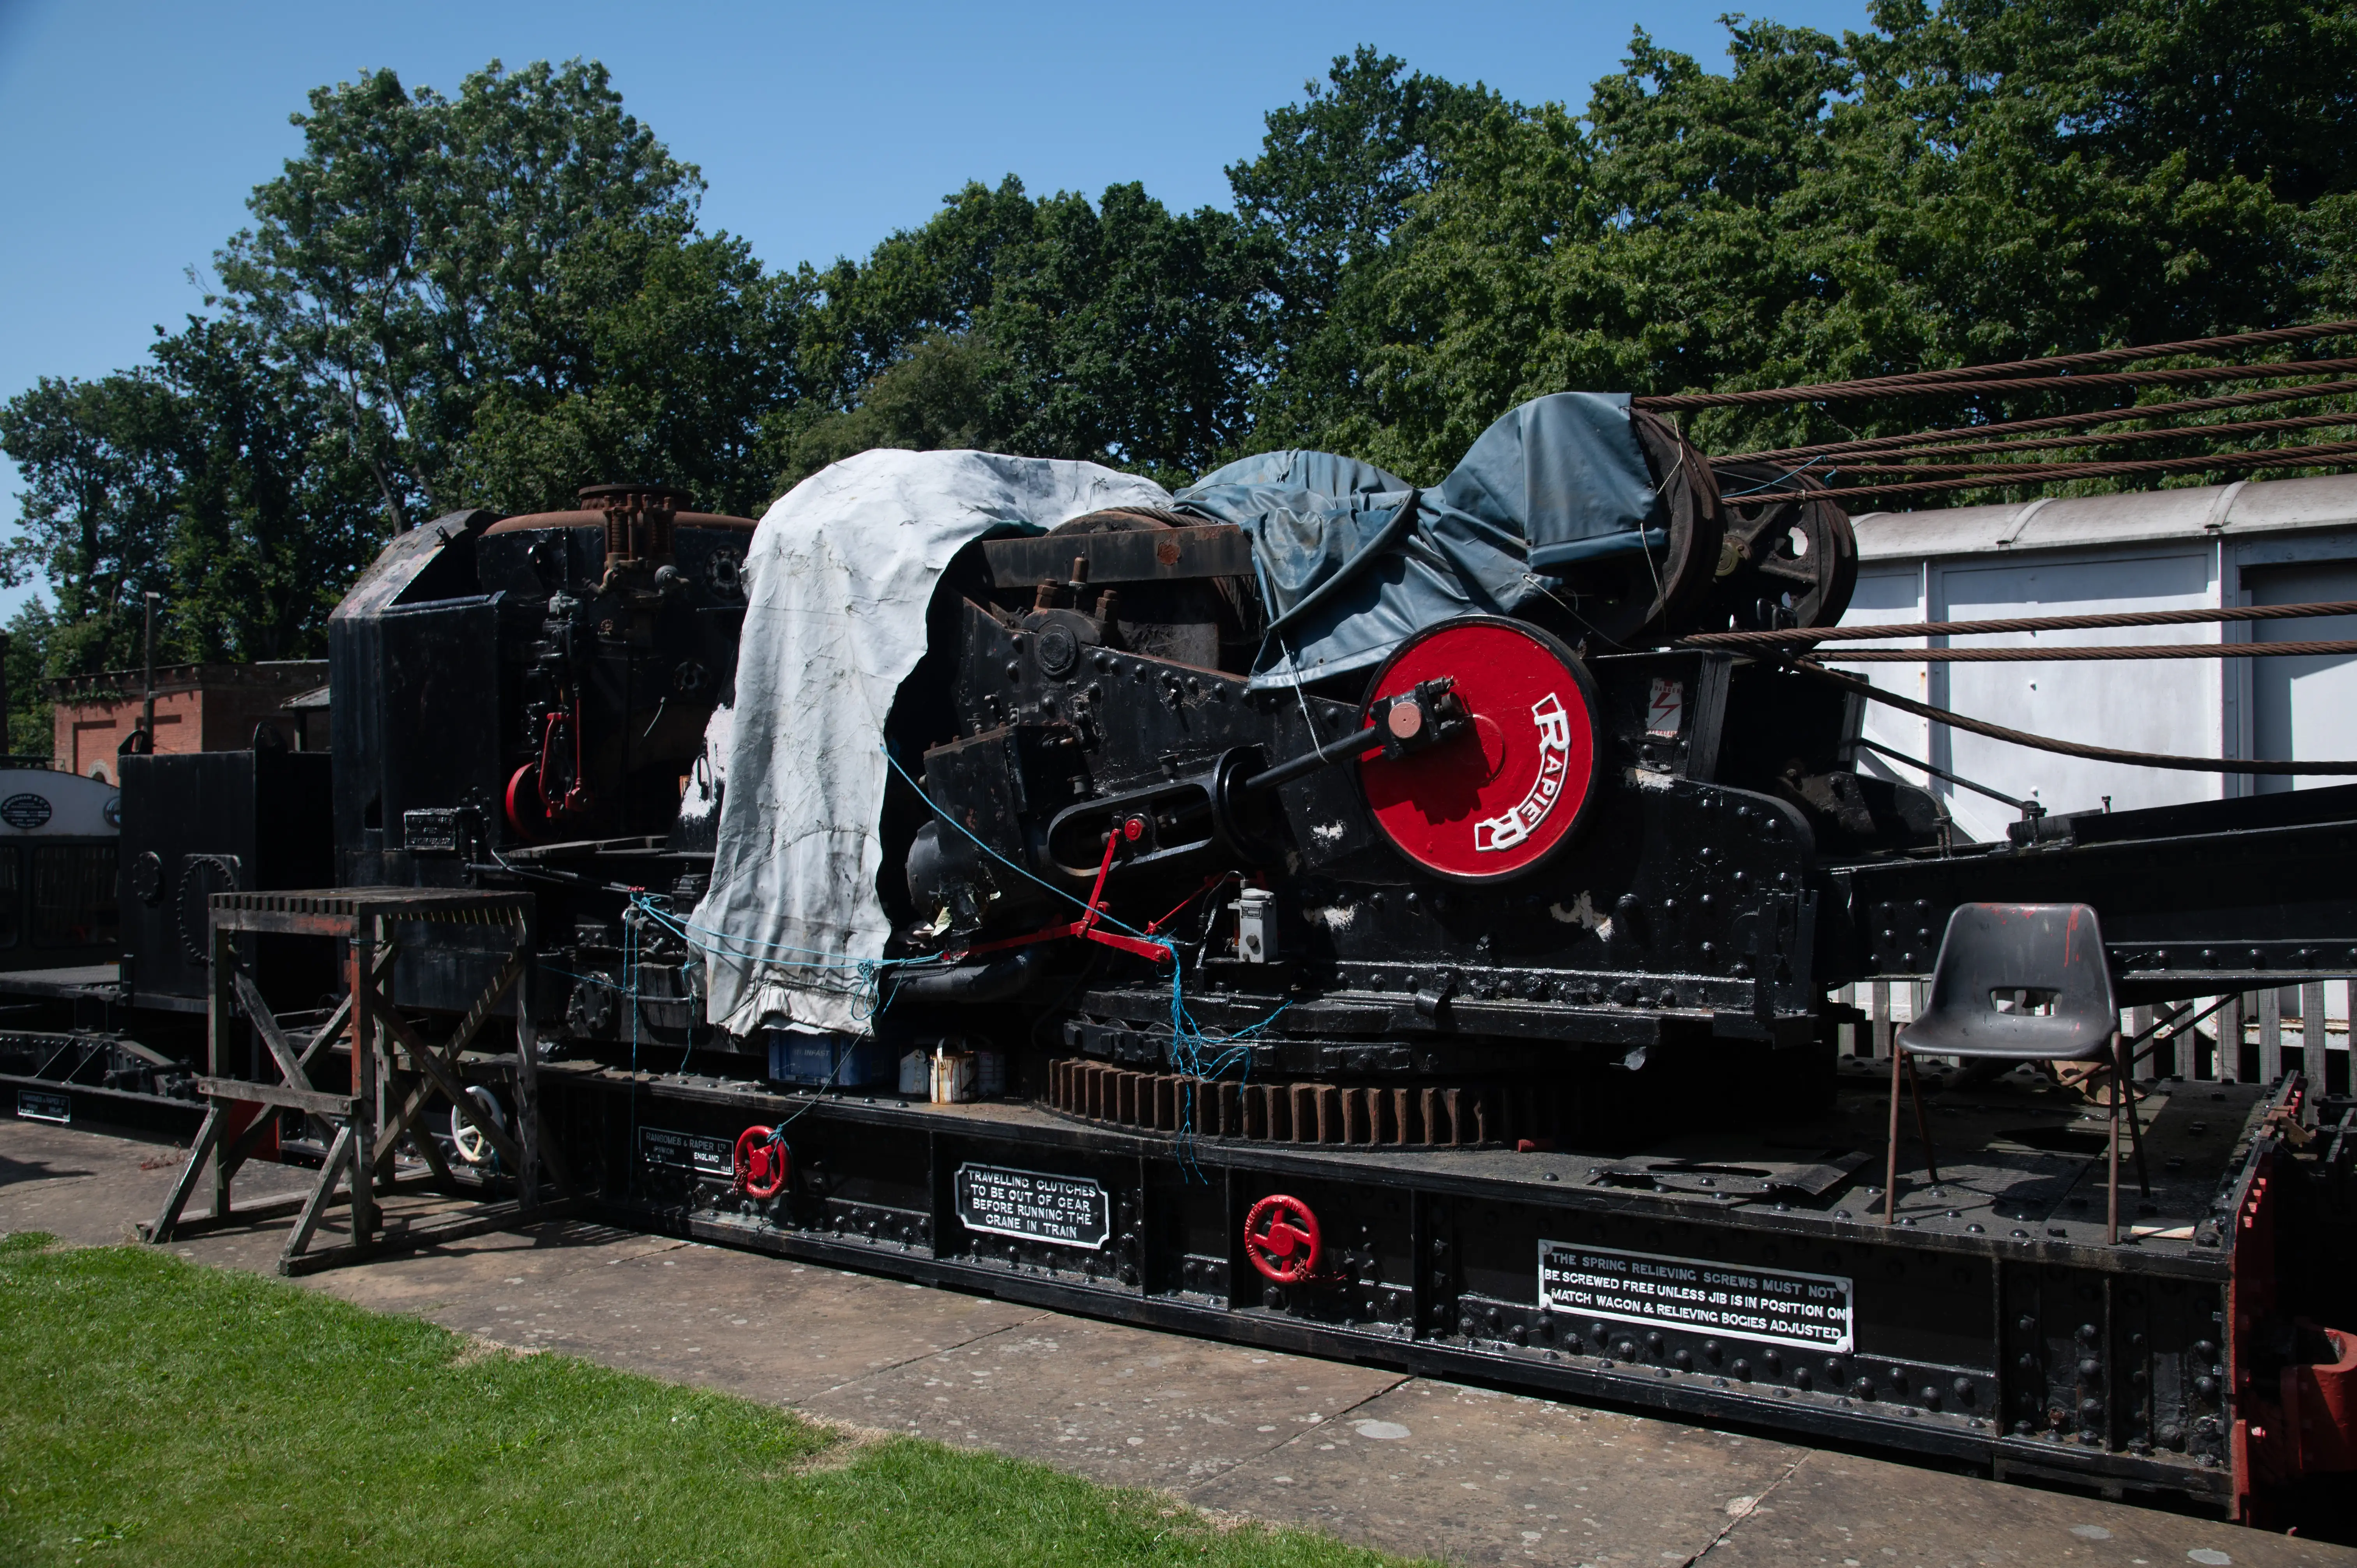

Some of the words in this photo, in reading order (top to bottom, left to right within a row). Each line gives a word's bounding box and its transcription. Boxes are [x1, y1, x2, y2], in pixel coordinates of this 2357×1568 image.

[1655, 685, 1680, 694] DANGER
[1489, 709, 1571, 850] RAPIER
[804, 1049, 830, 1057] INFAST
[646, 1132, 681, 1146] RANSOMES
[689, 1139, 714, 1151] RAPIER
[694, 1152, 719, 1163] ENGLAND
[967, 1170, 1030, 1188] TRAVELLING
[1037, 1180, 1096, 1197] CLUTCHES
[970, 1184, 986, 1196] TO
[991, 1187, 1005, 1199] BE
[1009, 1190, 1034, 1203] OUT
[1038, 1194, 1052, 1206] OF
[1058, 1197, 1090, 1212] GEAR
[973, 1198, 1013, 1215] BEFORE
[1018, 1204, 1063, 1221] RUNNING
[1067, 1211, 1092, 1225] THE
[986, 1214, 1021, 1229] CRANE
[1027, 1220, 1037, 1232] IN
[1043, 1223, 1077, 1239] TRAIN
[1551, 1252, 1577, 1266] THE
[1582, 1256, 1627, 1272] SPRING
[1632, 1263, 1697, 1281] RELIEVING
[1703, 1272, 1758, 1289] SCREWS
[1763, 1279, 1803, 1296] MUST
[1808, 1285, 1837, 1300] NOT
[1544, 1269, 1560, 1282] BE
[1562, 1271, 1619, 1289] SCREWED
[1623, 1280, 1655, 1294] FREE
[1657, 1286, 1706, 1302] UNLESS
[1709, 1292, 1727, 1305] JIB
[1730, 1295, 1743, 1307] IS
[1745, 1296, 1757, 1309] IN
[1760, 1298, 1824, 1318] POSITION
[1827, 1307, 1846, 1321] ON
[1551, 1288, 1592, 1305] MATCH
[1596, 1295, 1640, 1312] WAGON
[1643, 1302, 1654, 1314] &
[1656, 1303, 1718, 1323] RELIEVING
[1721, 1312, 1767, 1330] BOGIES
[1770, 1319, 1842, 1340] ADJUSTED
